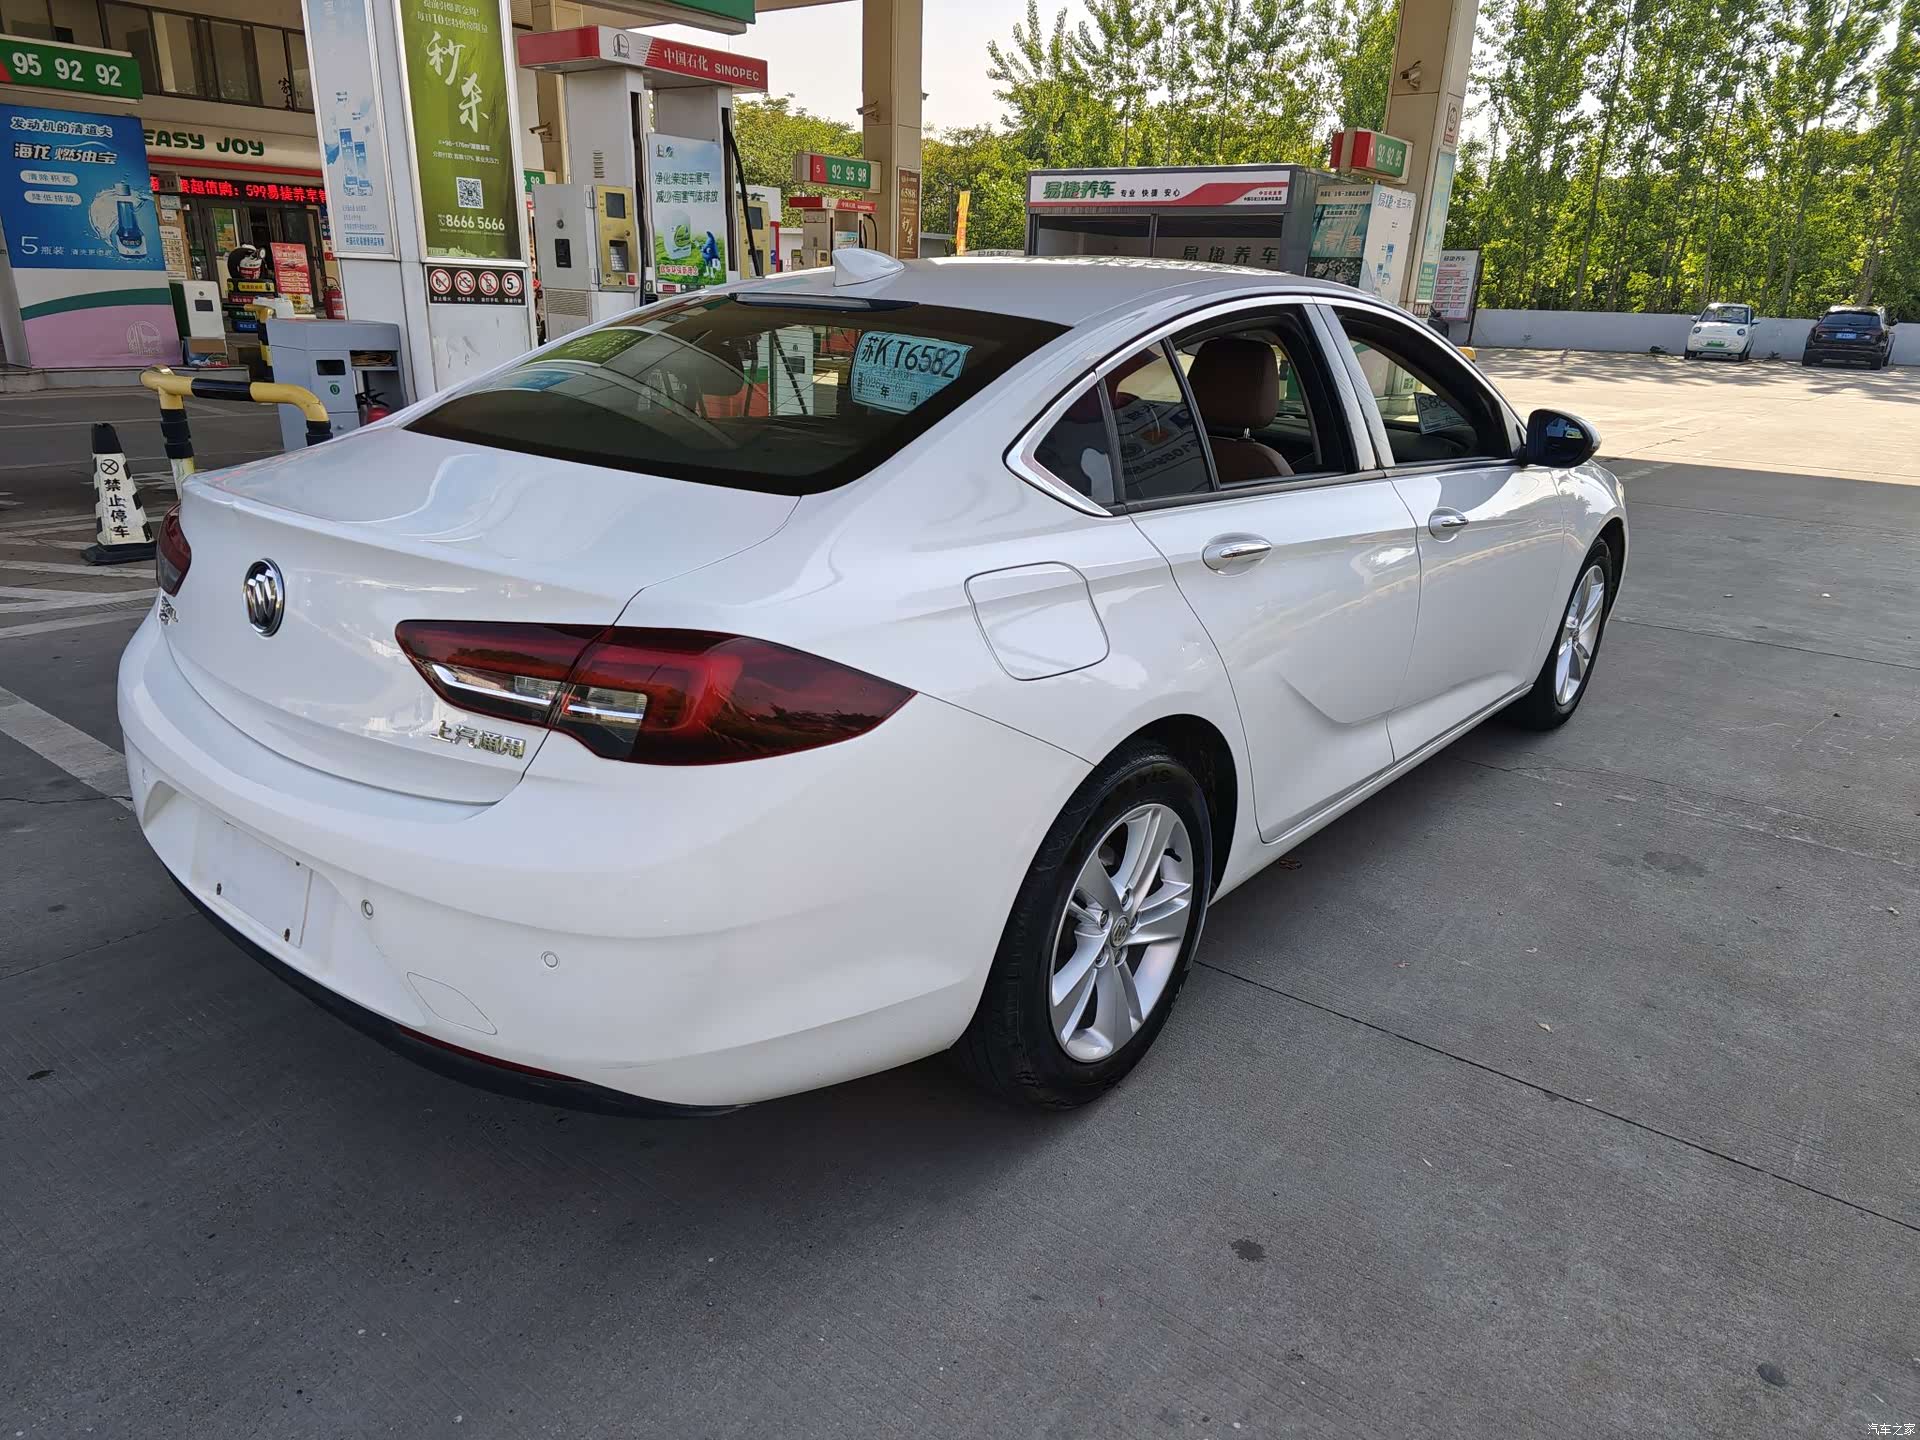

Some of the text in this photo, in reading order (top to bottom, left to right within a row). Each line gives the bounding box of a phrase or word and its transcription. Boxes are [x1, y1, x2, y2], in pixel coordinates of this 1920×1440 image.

[12, 52, 122, 87] 95 92 92
[664, 47, 760, 81] 中国石化 SINOPEC
[10, 116, 114, 138] 发动机的清道夫
[143, 129, 265, 157] EASY JOY
[832, 164, 841, 180] 92
[845, 166, 854, 181] 95
[858, 168, 867, 183] 98
[1043, 180, 1181, 199] 易捷养车 专业 快捷 安心
[445, 214, 506, 231] 8666 5666
[1183, 246, 1279, 264] 易捷养车
[506, 277, 514, 290] 5
[860, 335, 962, 379] 苏KT6582
[103, 478, 130, 538] 禁止停车
[429, 720, 526, 760] 上汽通用
